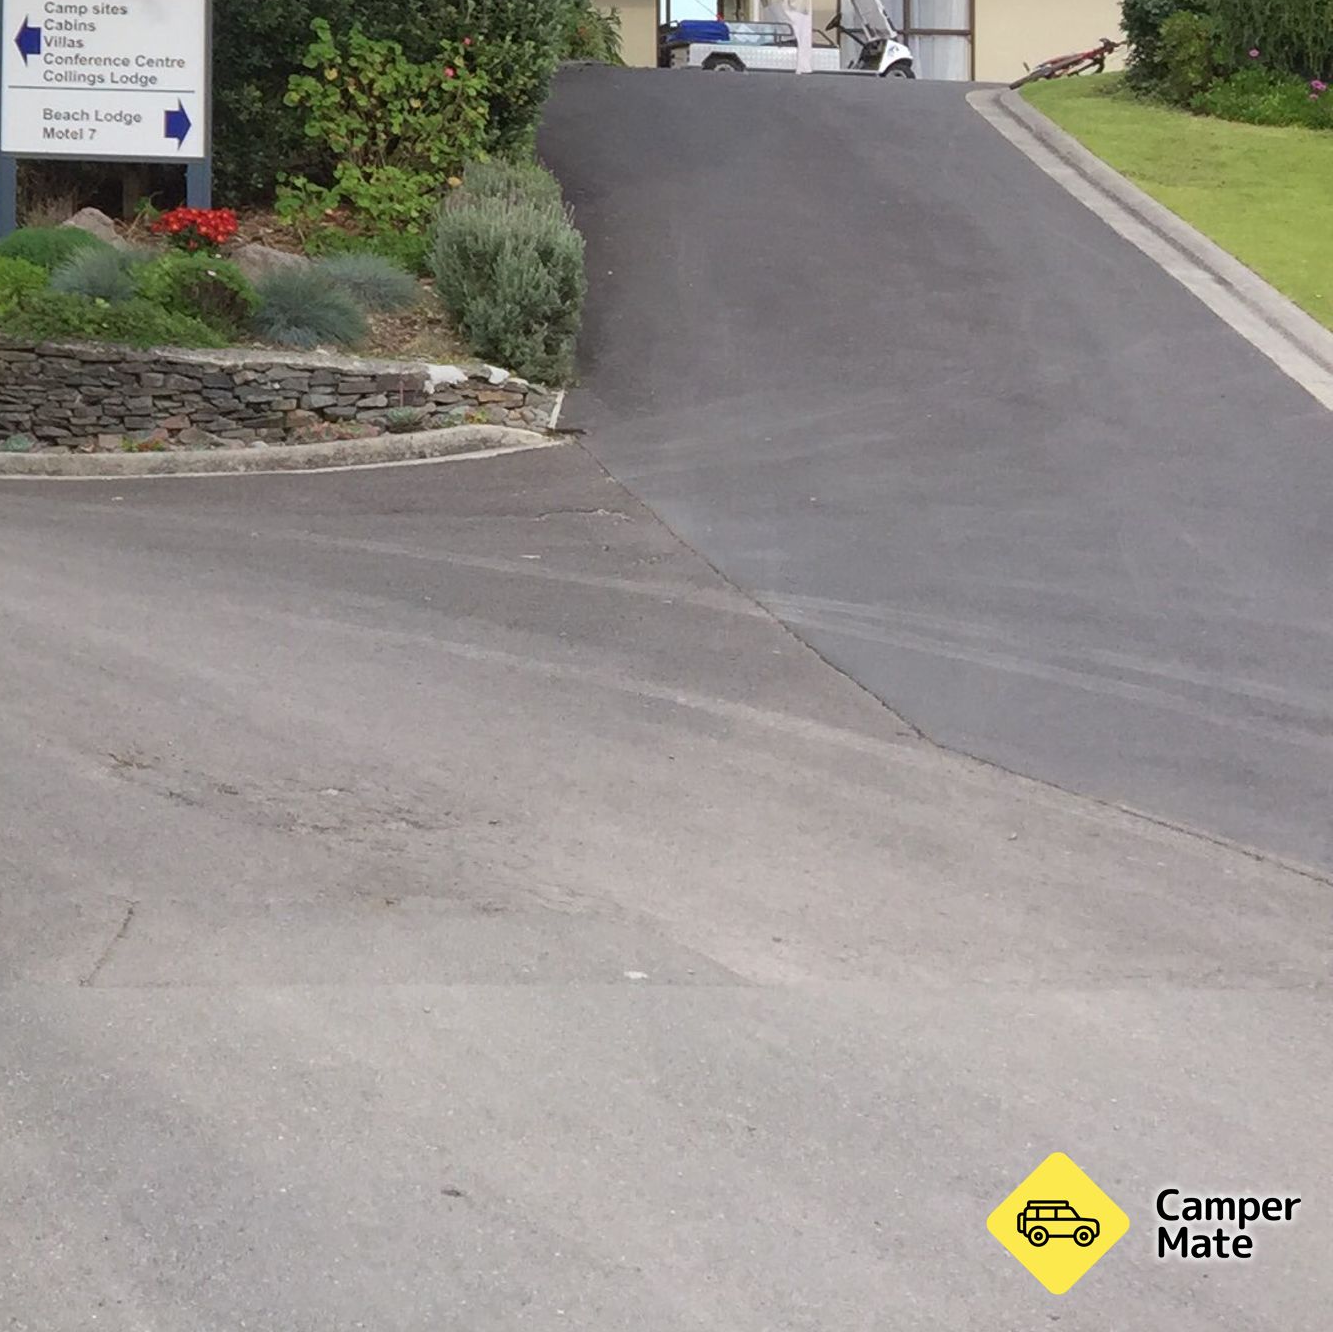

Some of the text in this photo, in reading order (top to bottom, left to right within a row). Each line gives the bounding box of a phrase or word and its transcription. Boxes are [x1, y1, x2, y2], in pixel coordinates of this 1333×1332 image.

[44, 1, 128, 15] Camp sites
[44, 18, 96, 32] Cabins
[44, 35, 84, 49] Villas
[43, 52, 186, 68] Conference Centre
[43, 70, 158, 87] Collings Lodge
[42, 108, 143, 125] Beach Lodge
[42, 127, 97, 140] Motel 7
